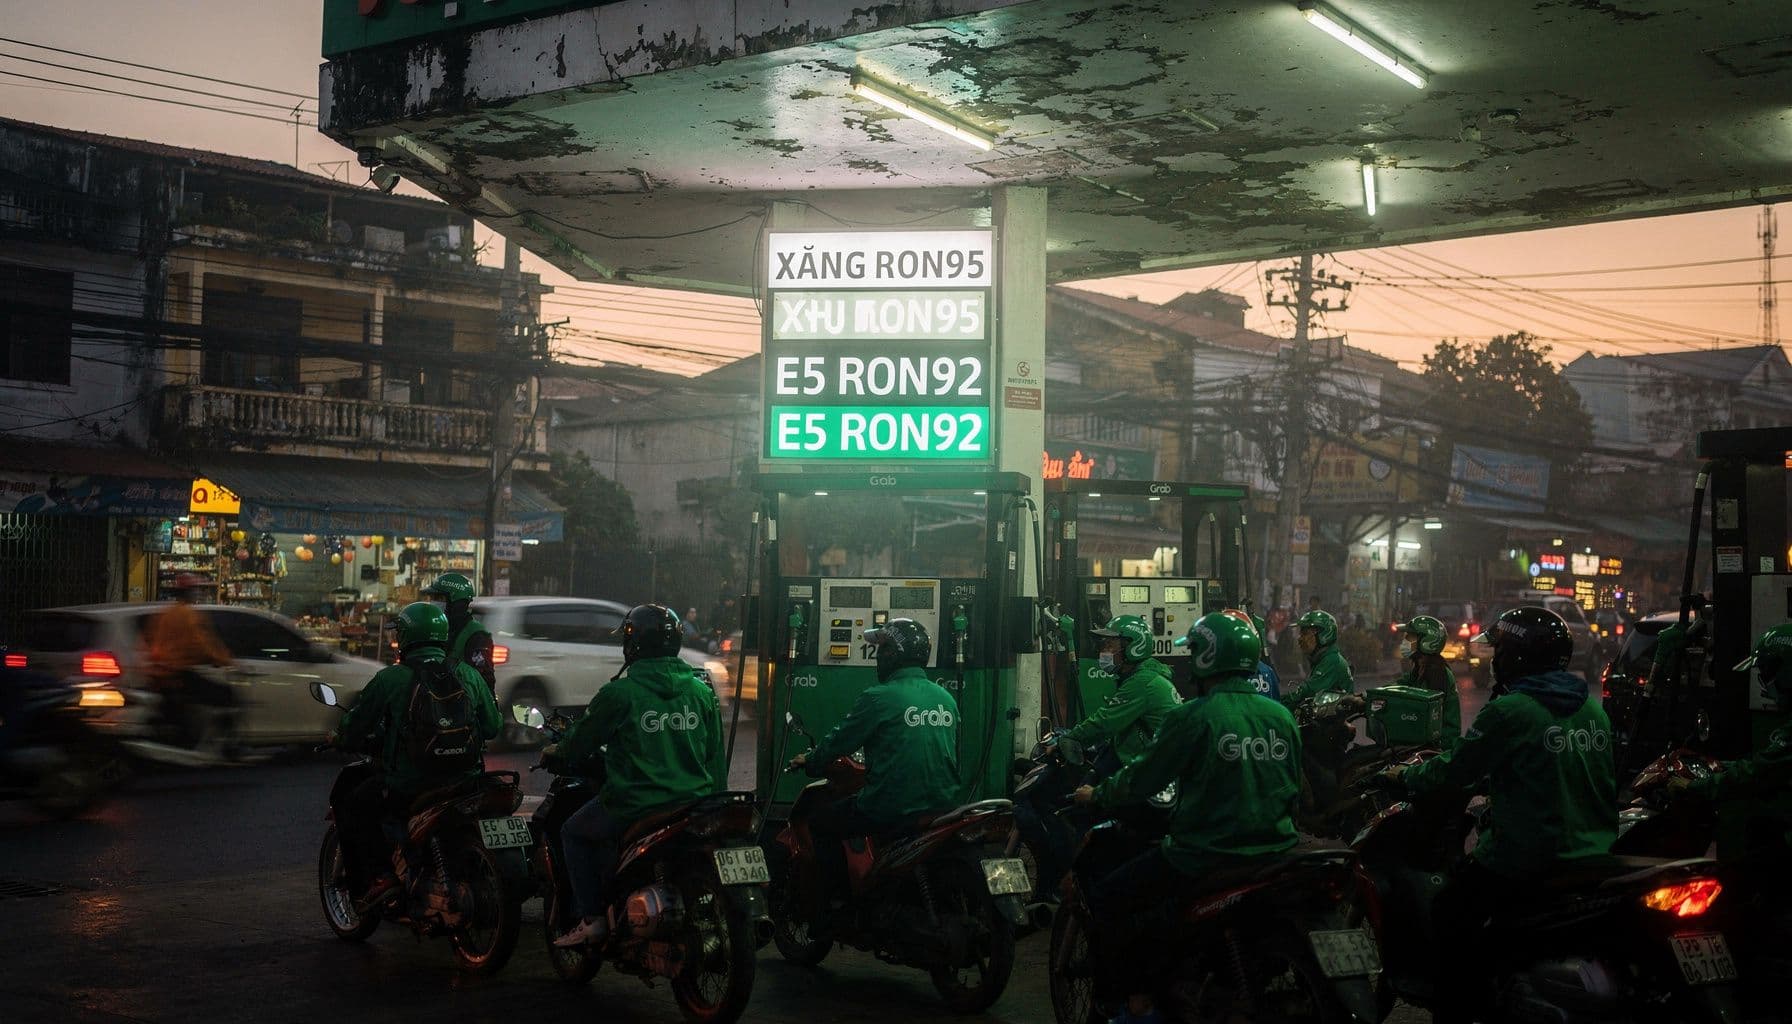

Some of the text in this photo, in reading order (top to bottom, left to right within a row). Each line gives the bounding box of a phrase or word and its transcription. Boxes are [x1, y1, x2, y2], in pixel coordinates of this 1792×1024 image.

[775, 245, 984, 280] XĂNG RON95
[776, 357, 982, 396] E5 RON92
[778, 413, 983, 451] E5 RON92
[640, 705, 699, 733] Grab
[904, 704, 954, 727] Grab
[1217, 728, 1289, 761] Grab
[1543, 720, 1609, 752] Grab
